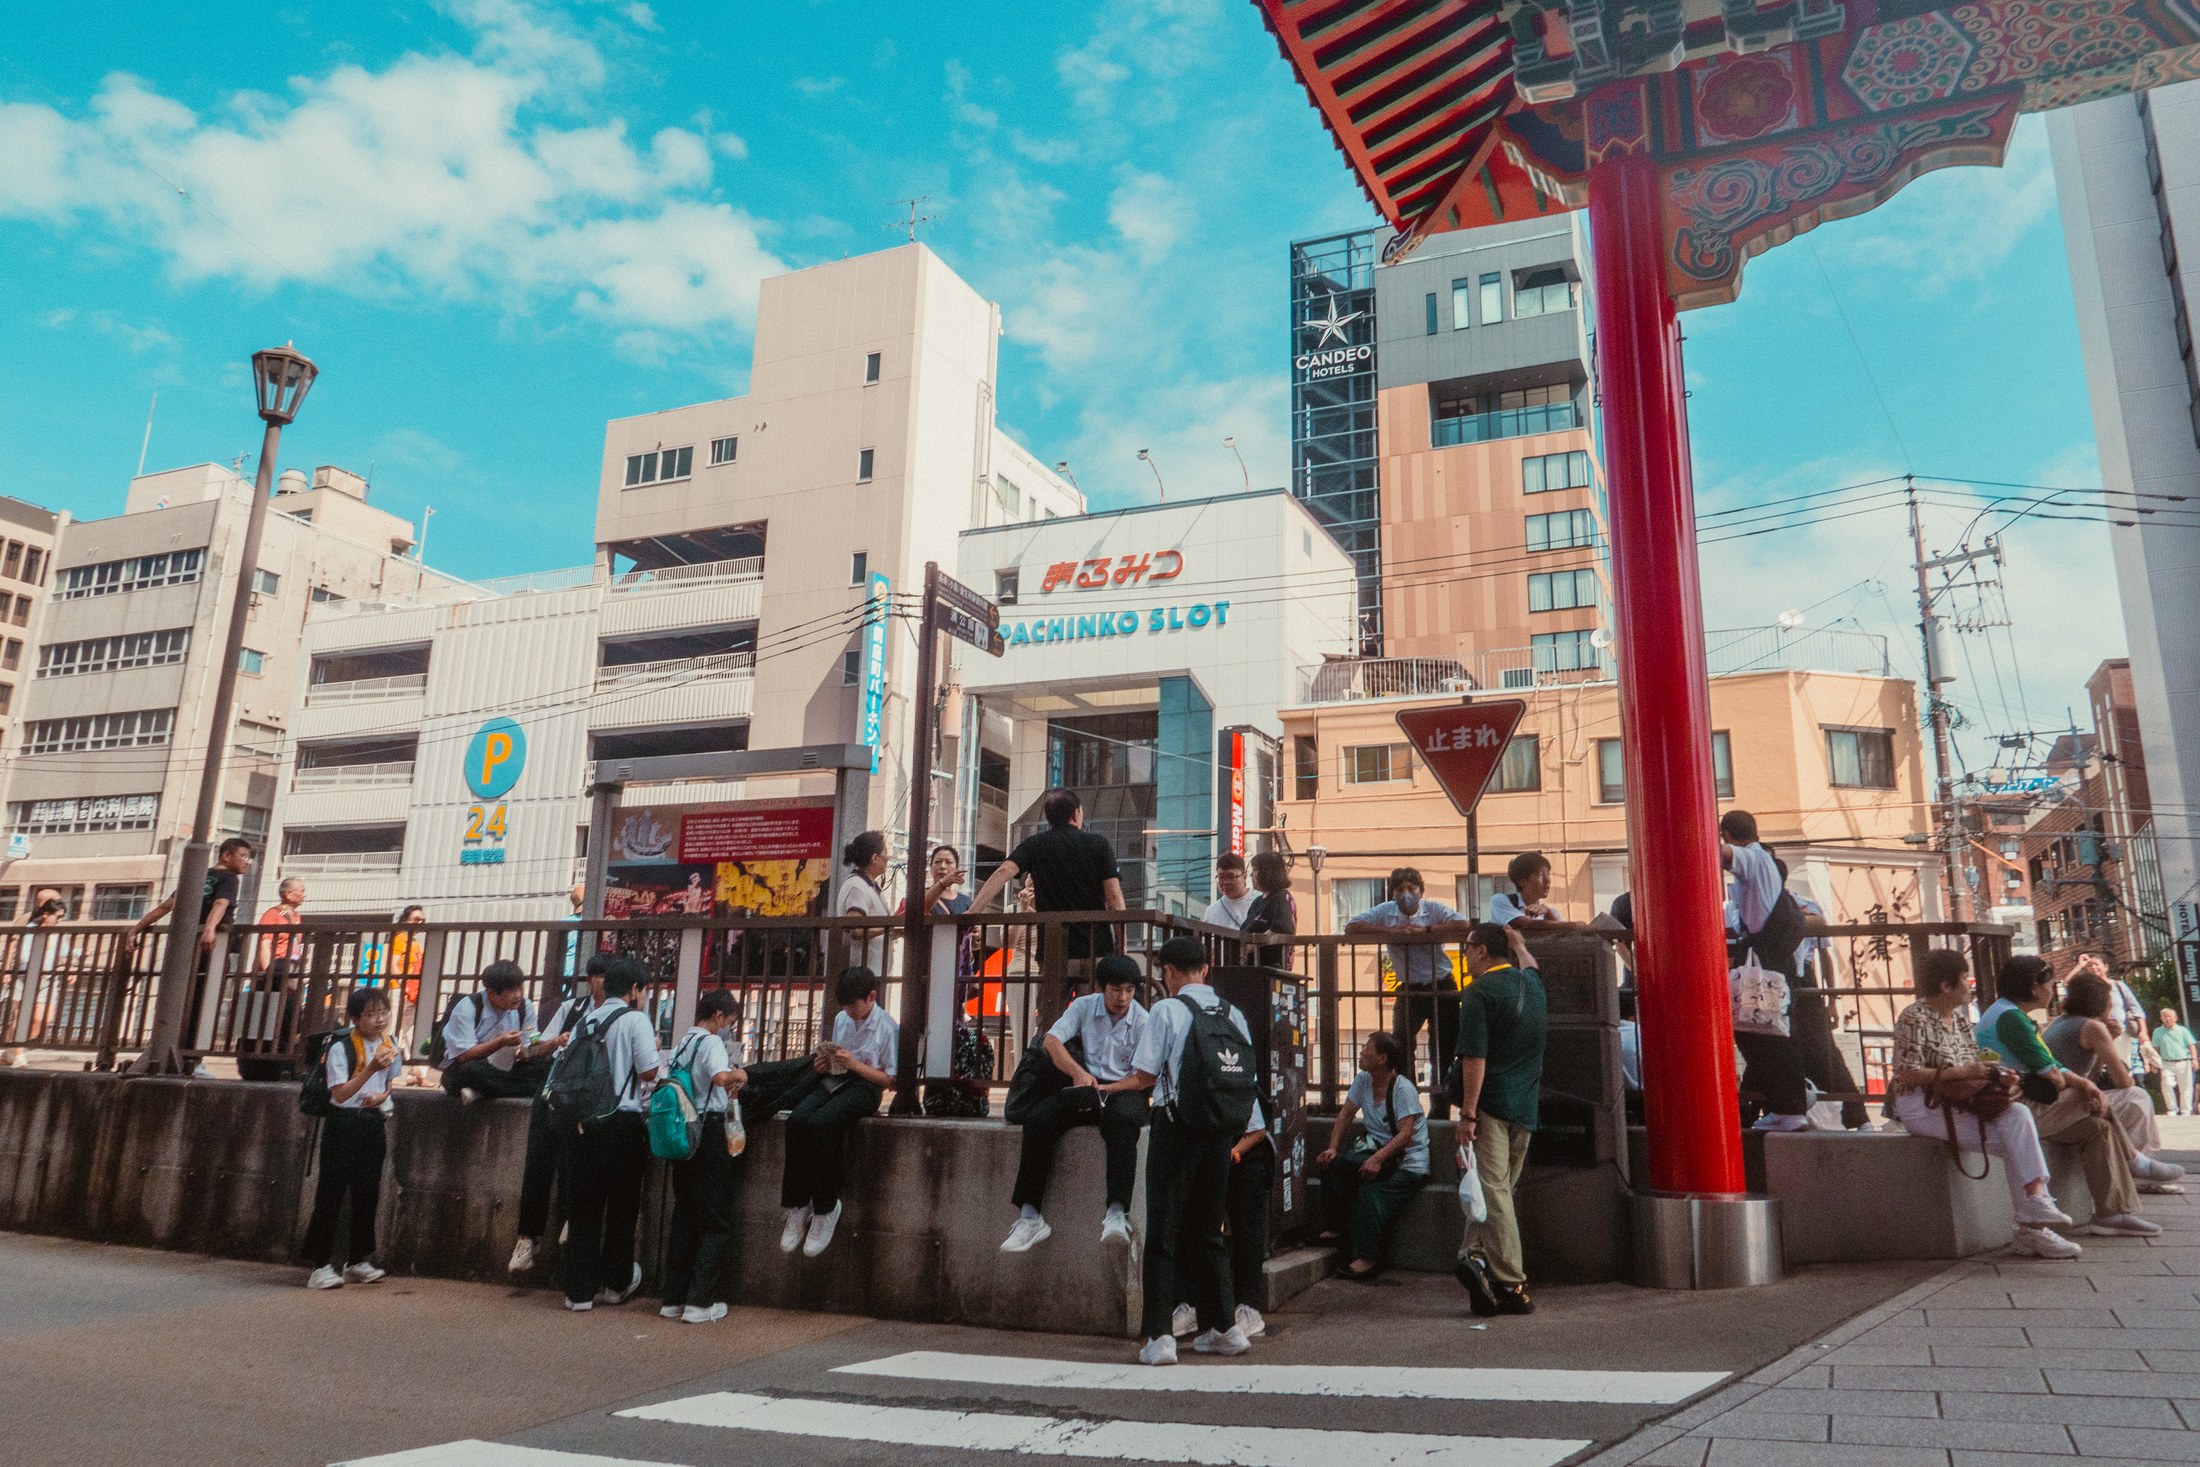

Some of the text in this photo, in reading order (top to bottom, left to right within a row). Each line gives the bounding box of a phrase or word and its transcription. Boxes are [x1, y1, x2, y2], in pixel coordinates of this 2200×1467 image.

[1296, 346, 1371, 369] CANDEO
[1312, 363, 1355, 378] HOTELS
[1041, 550, 1184, 592] まるみつ
[998, 610, 1139, 646] PACHINKO
[1150, 600, 1230, 632] SLOT
[1425, 723, 1500, 752] 止まれ
[482, 733, 512, 784] P
[465, 804, 507, 841] 24
[1220, 1064, 1244, 1073] adidas
